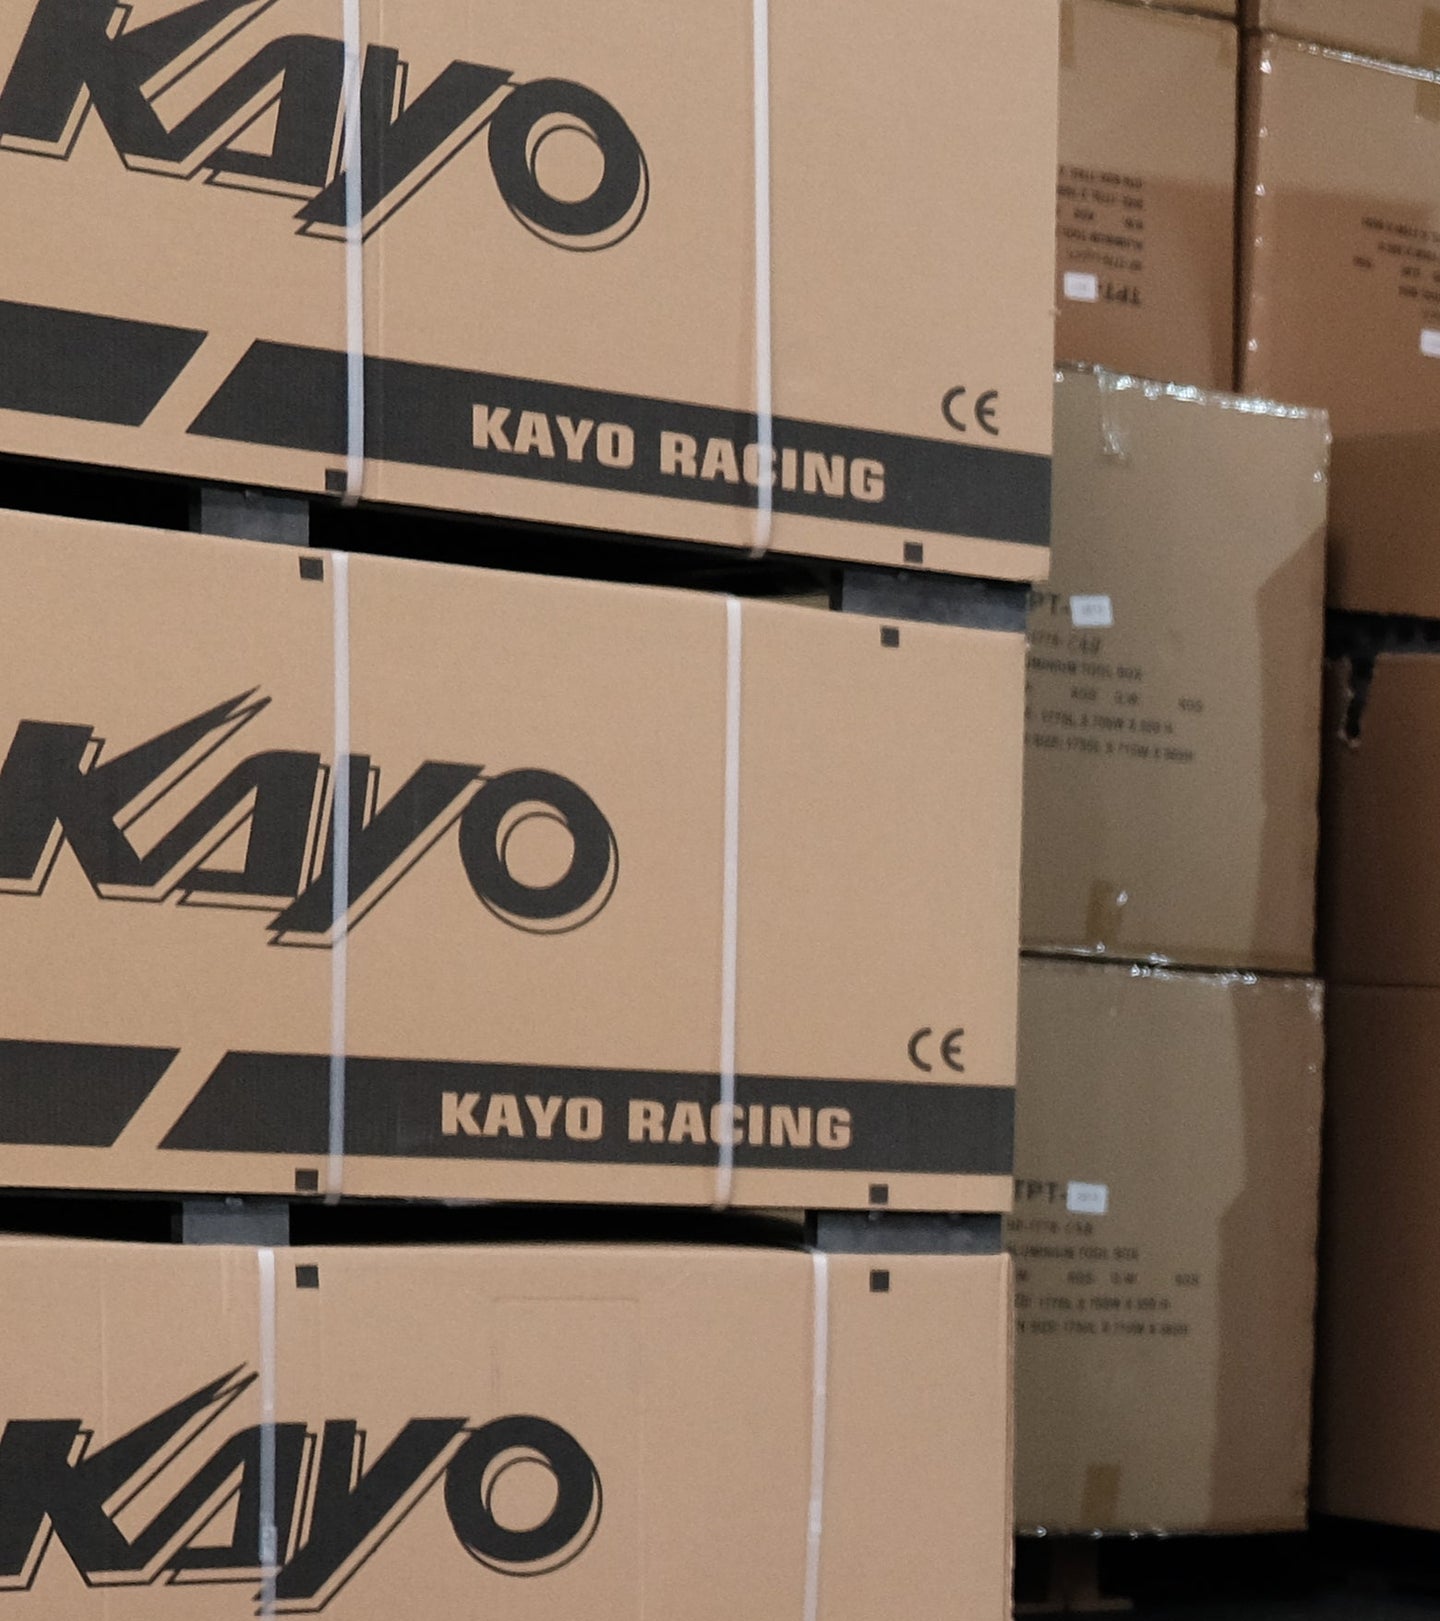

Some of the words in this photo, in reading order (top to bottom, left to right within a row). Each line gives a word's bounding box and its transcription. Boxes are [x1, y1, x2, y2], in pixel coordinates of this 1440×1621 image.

[0, 0, 648, 251] KAYO
[471, 403, 635, 467] KAYO
[660, 430, 886, 503] RACING
[0, 686, 618, 948] KAYO
[440, 1090, 602, 1140] KAYO
[628, 1097, 853, 1149] RACING
[0, 1362, 602, 1615] KAYO
